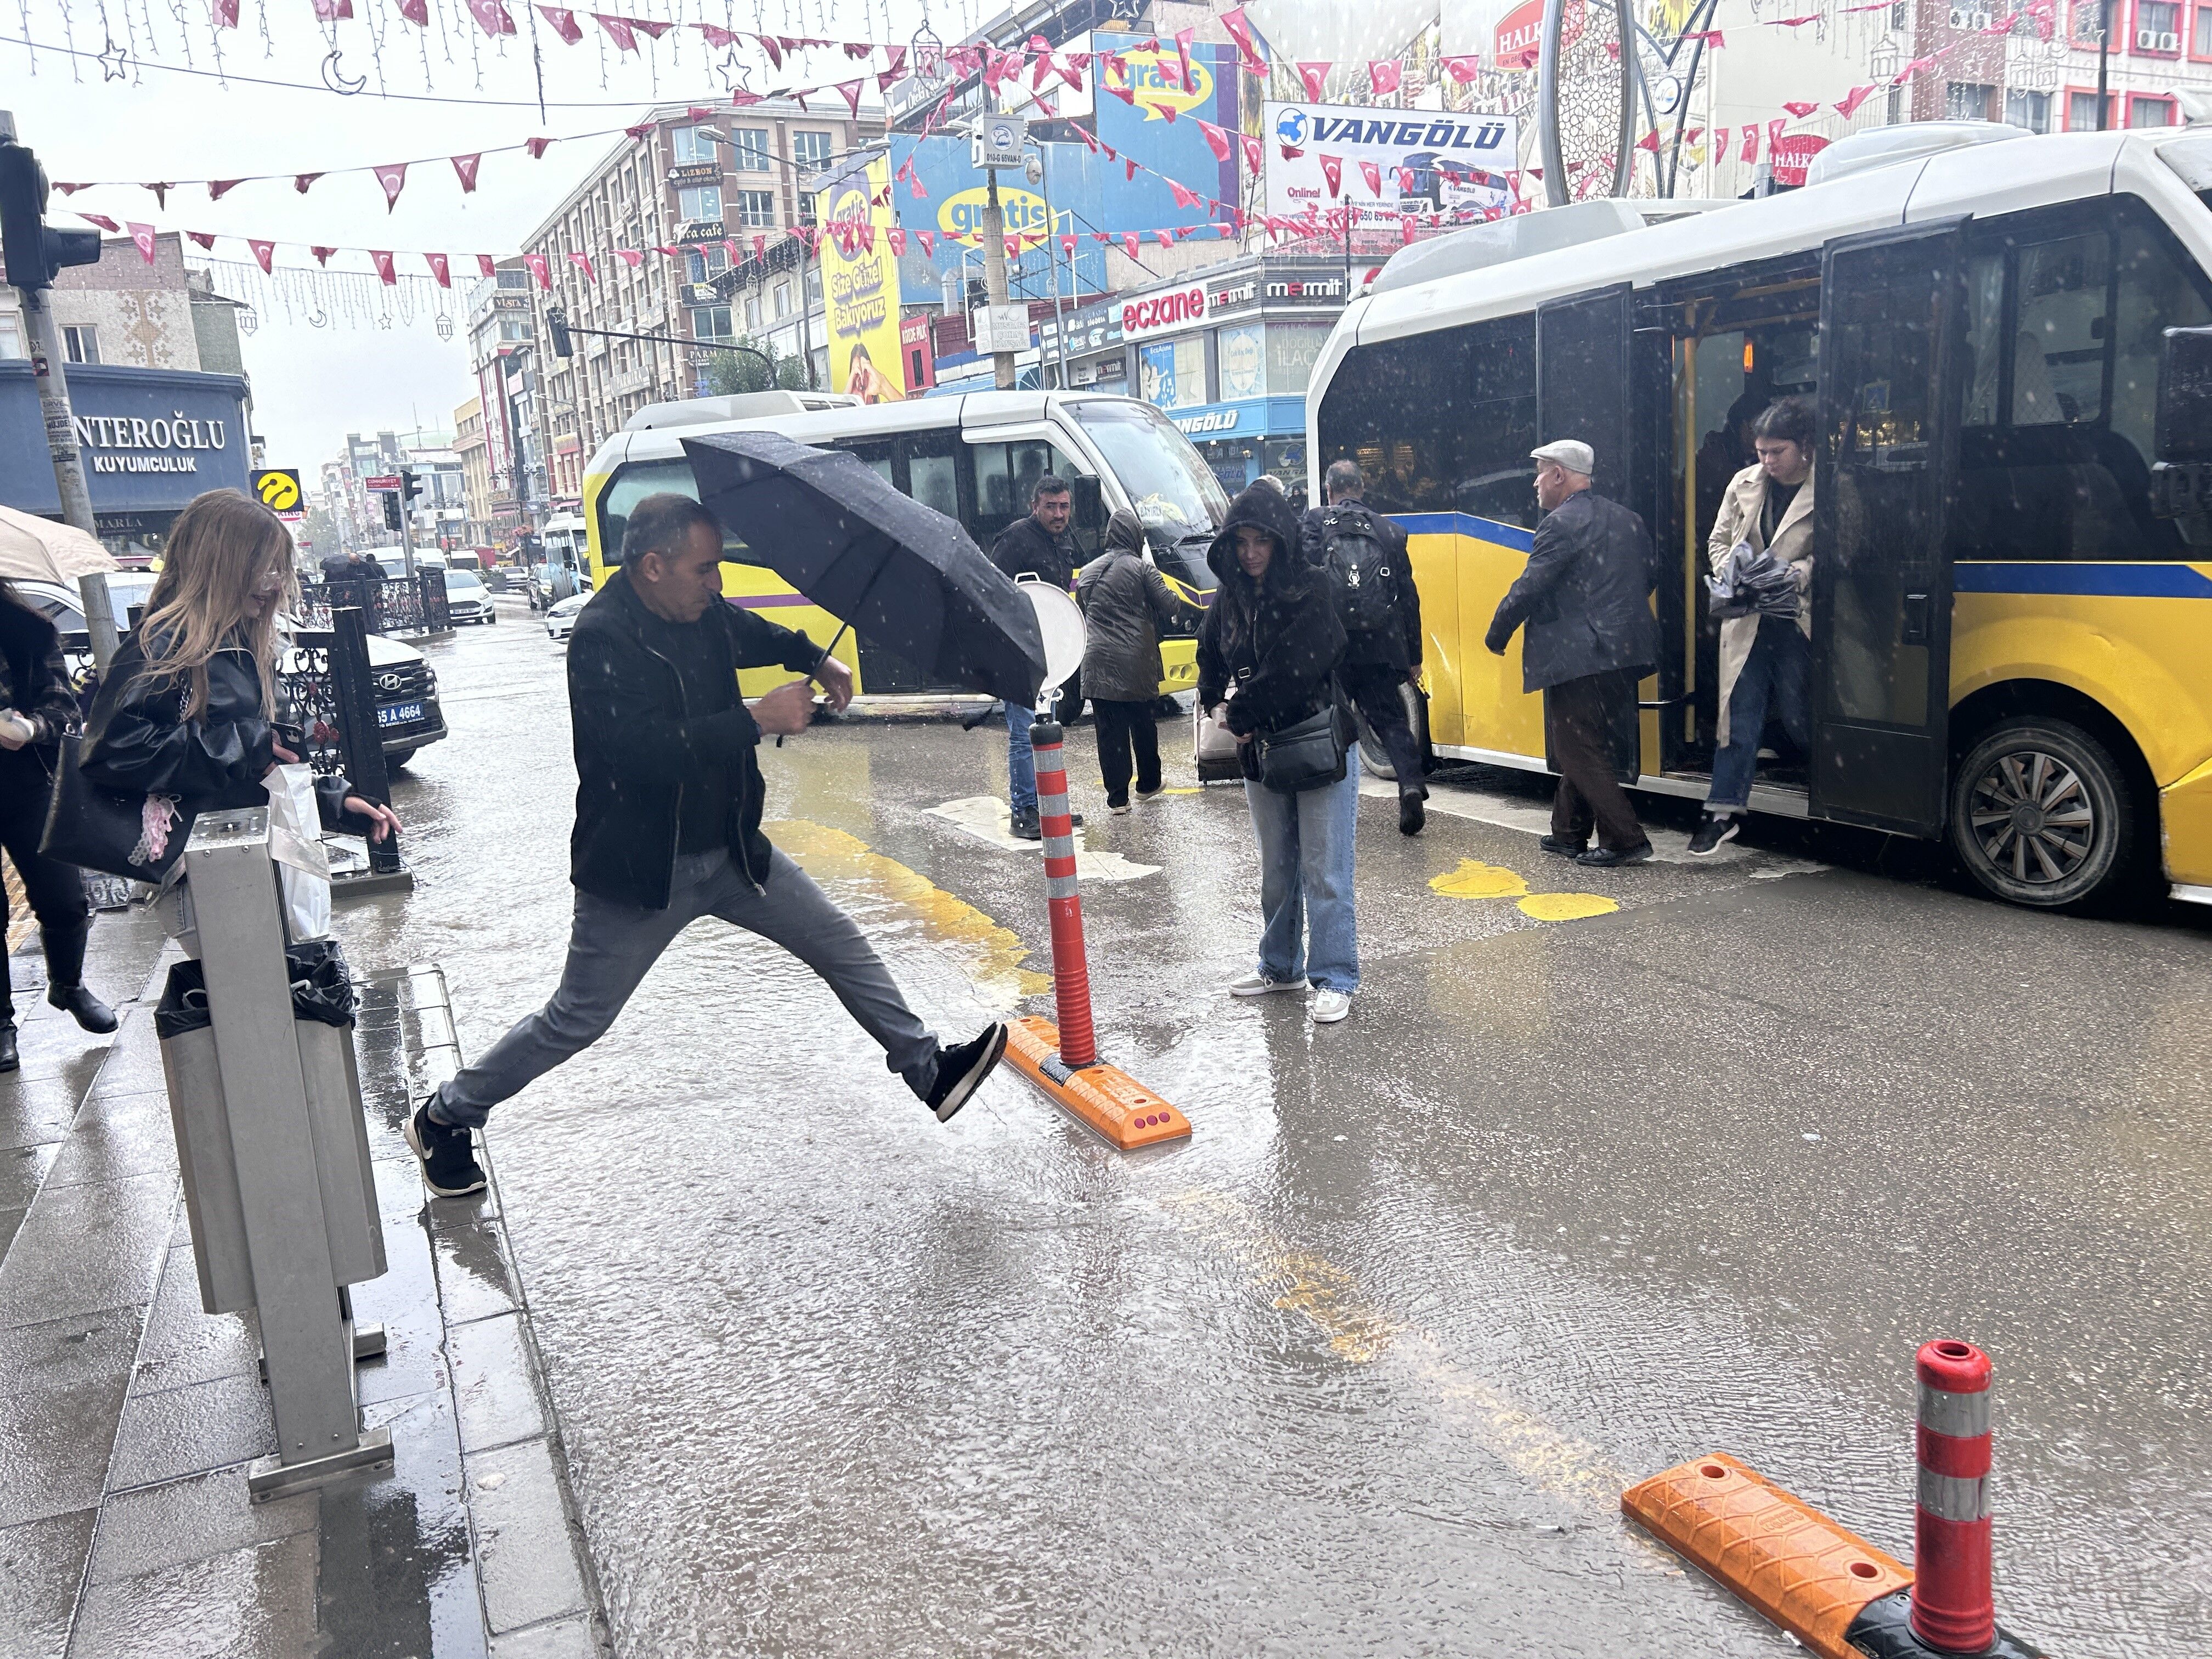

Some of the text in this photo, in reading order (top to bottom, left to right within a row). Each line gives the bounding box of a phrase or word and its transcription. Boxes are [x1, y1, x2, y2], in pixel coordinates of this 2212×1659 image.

[1311, 117, 1506, 149] VANGÖLÜ
[1287, 187, 1321, 198] Online!
[951, 195, 1047, 234] grtis
[831, 272, 852, 299] Size
[1267, 278, 1342, 298] mermit
[834, 296, 886, 333] Bakıyoruz
[1123, 288, 1204, 331] eczane
[1208, 280, 1257, 308] mermit
[902, 326, 916, 345] KÖZDE
[74, 411, 225, 450] NTEROĞLU
[94, 456, 197, 473] KUYUMCULUK
[390, 708, 398, 721] A
[399, 704, 421, 719] 4664
